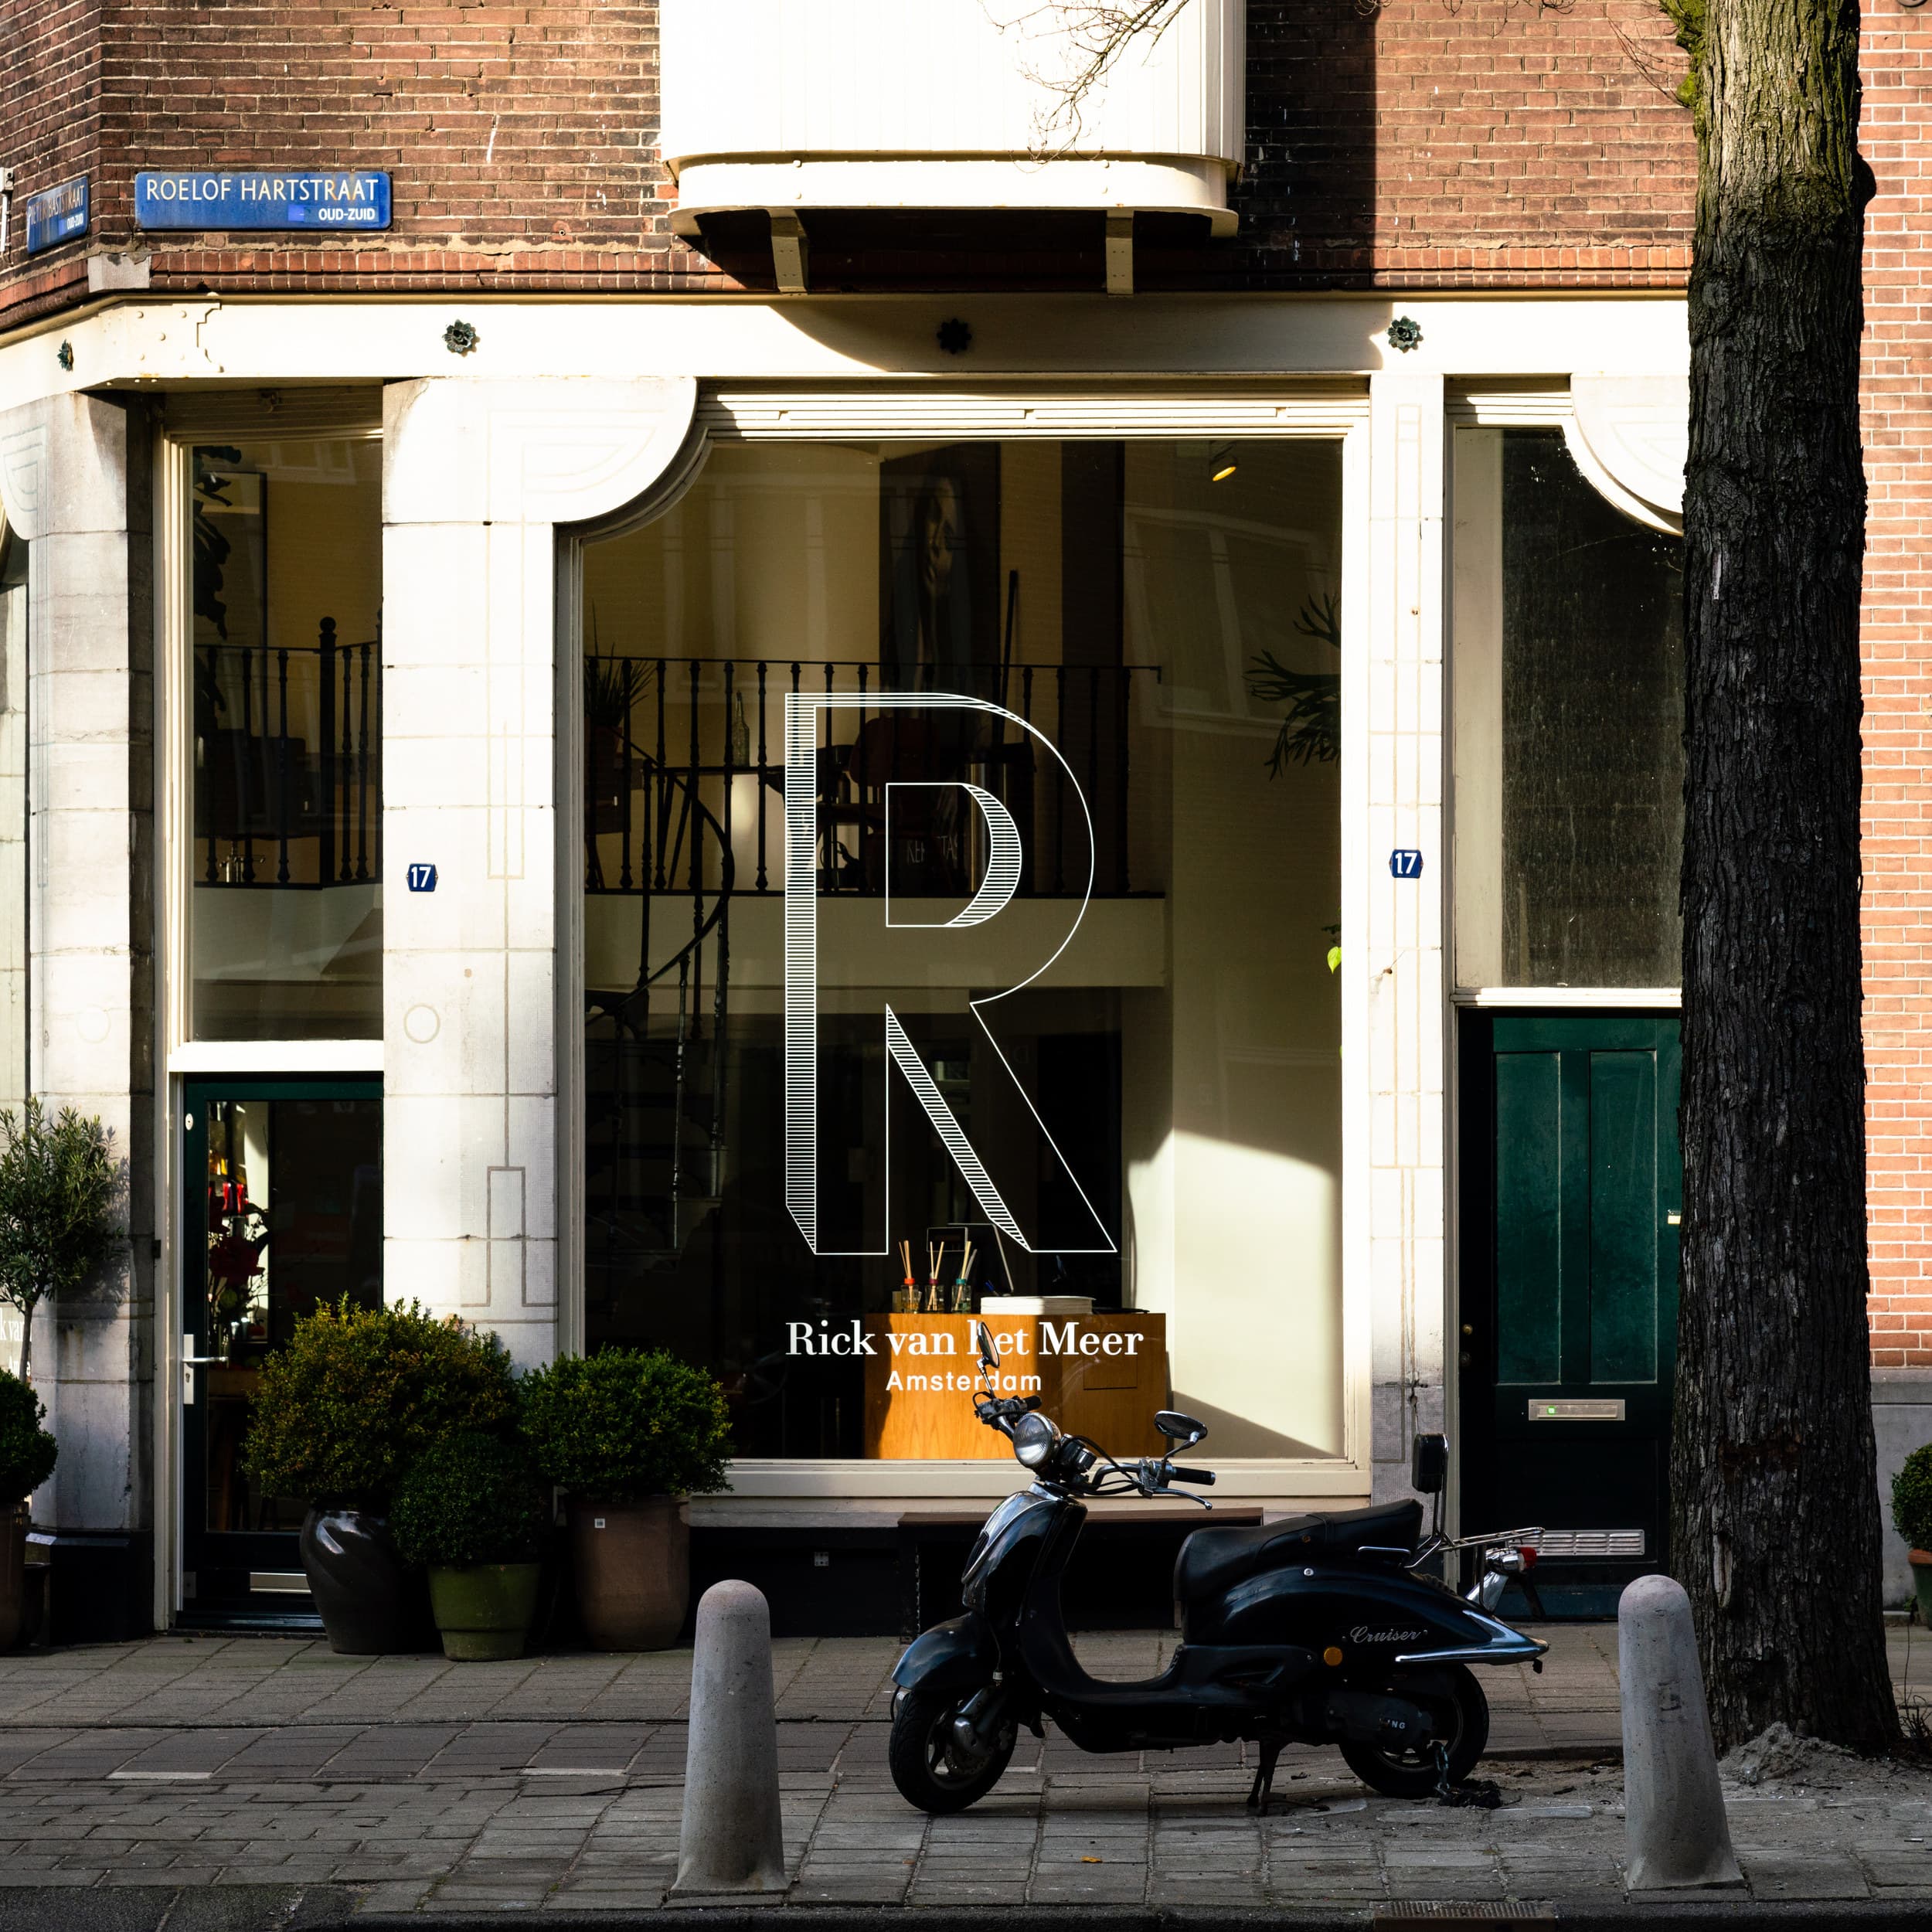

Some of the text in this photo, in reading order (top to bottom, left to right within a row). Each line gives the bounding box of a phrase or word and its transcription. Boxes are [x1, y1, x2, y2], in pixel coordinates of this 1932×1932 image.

[147, 179, 379, 202] ROELOF HARTSTRAAT
[318, 207, 376, 222] OUD-ZUID
[1395, 852, 1418, 875] 17
[411, 866, 432, 888] 17
[784, 692, 1118, 1256] R
[785, 1319, 878, 1356] Rick
[885, 1332, 957, 1356] van
[1038, 1321, 1145, 1356] Meer
[886, 1370, 1042, 1392] Amsterdam
[1349, 1625, 1422, 1644] Cruiser
